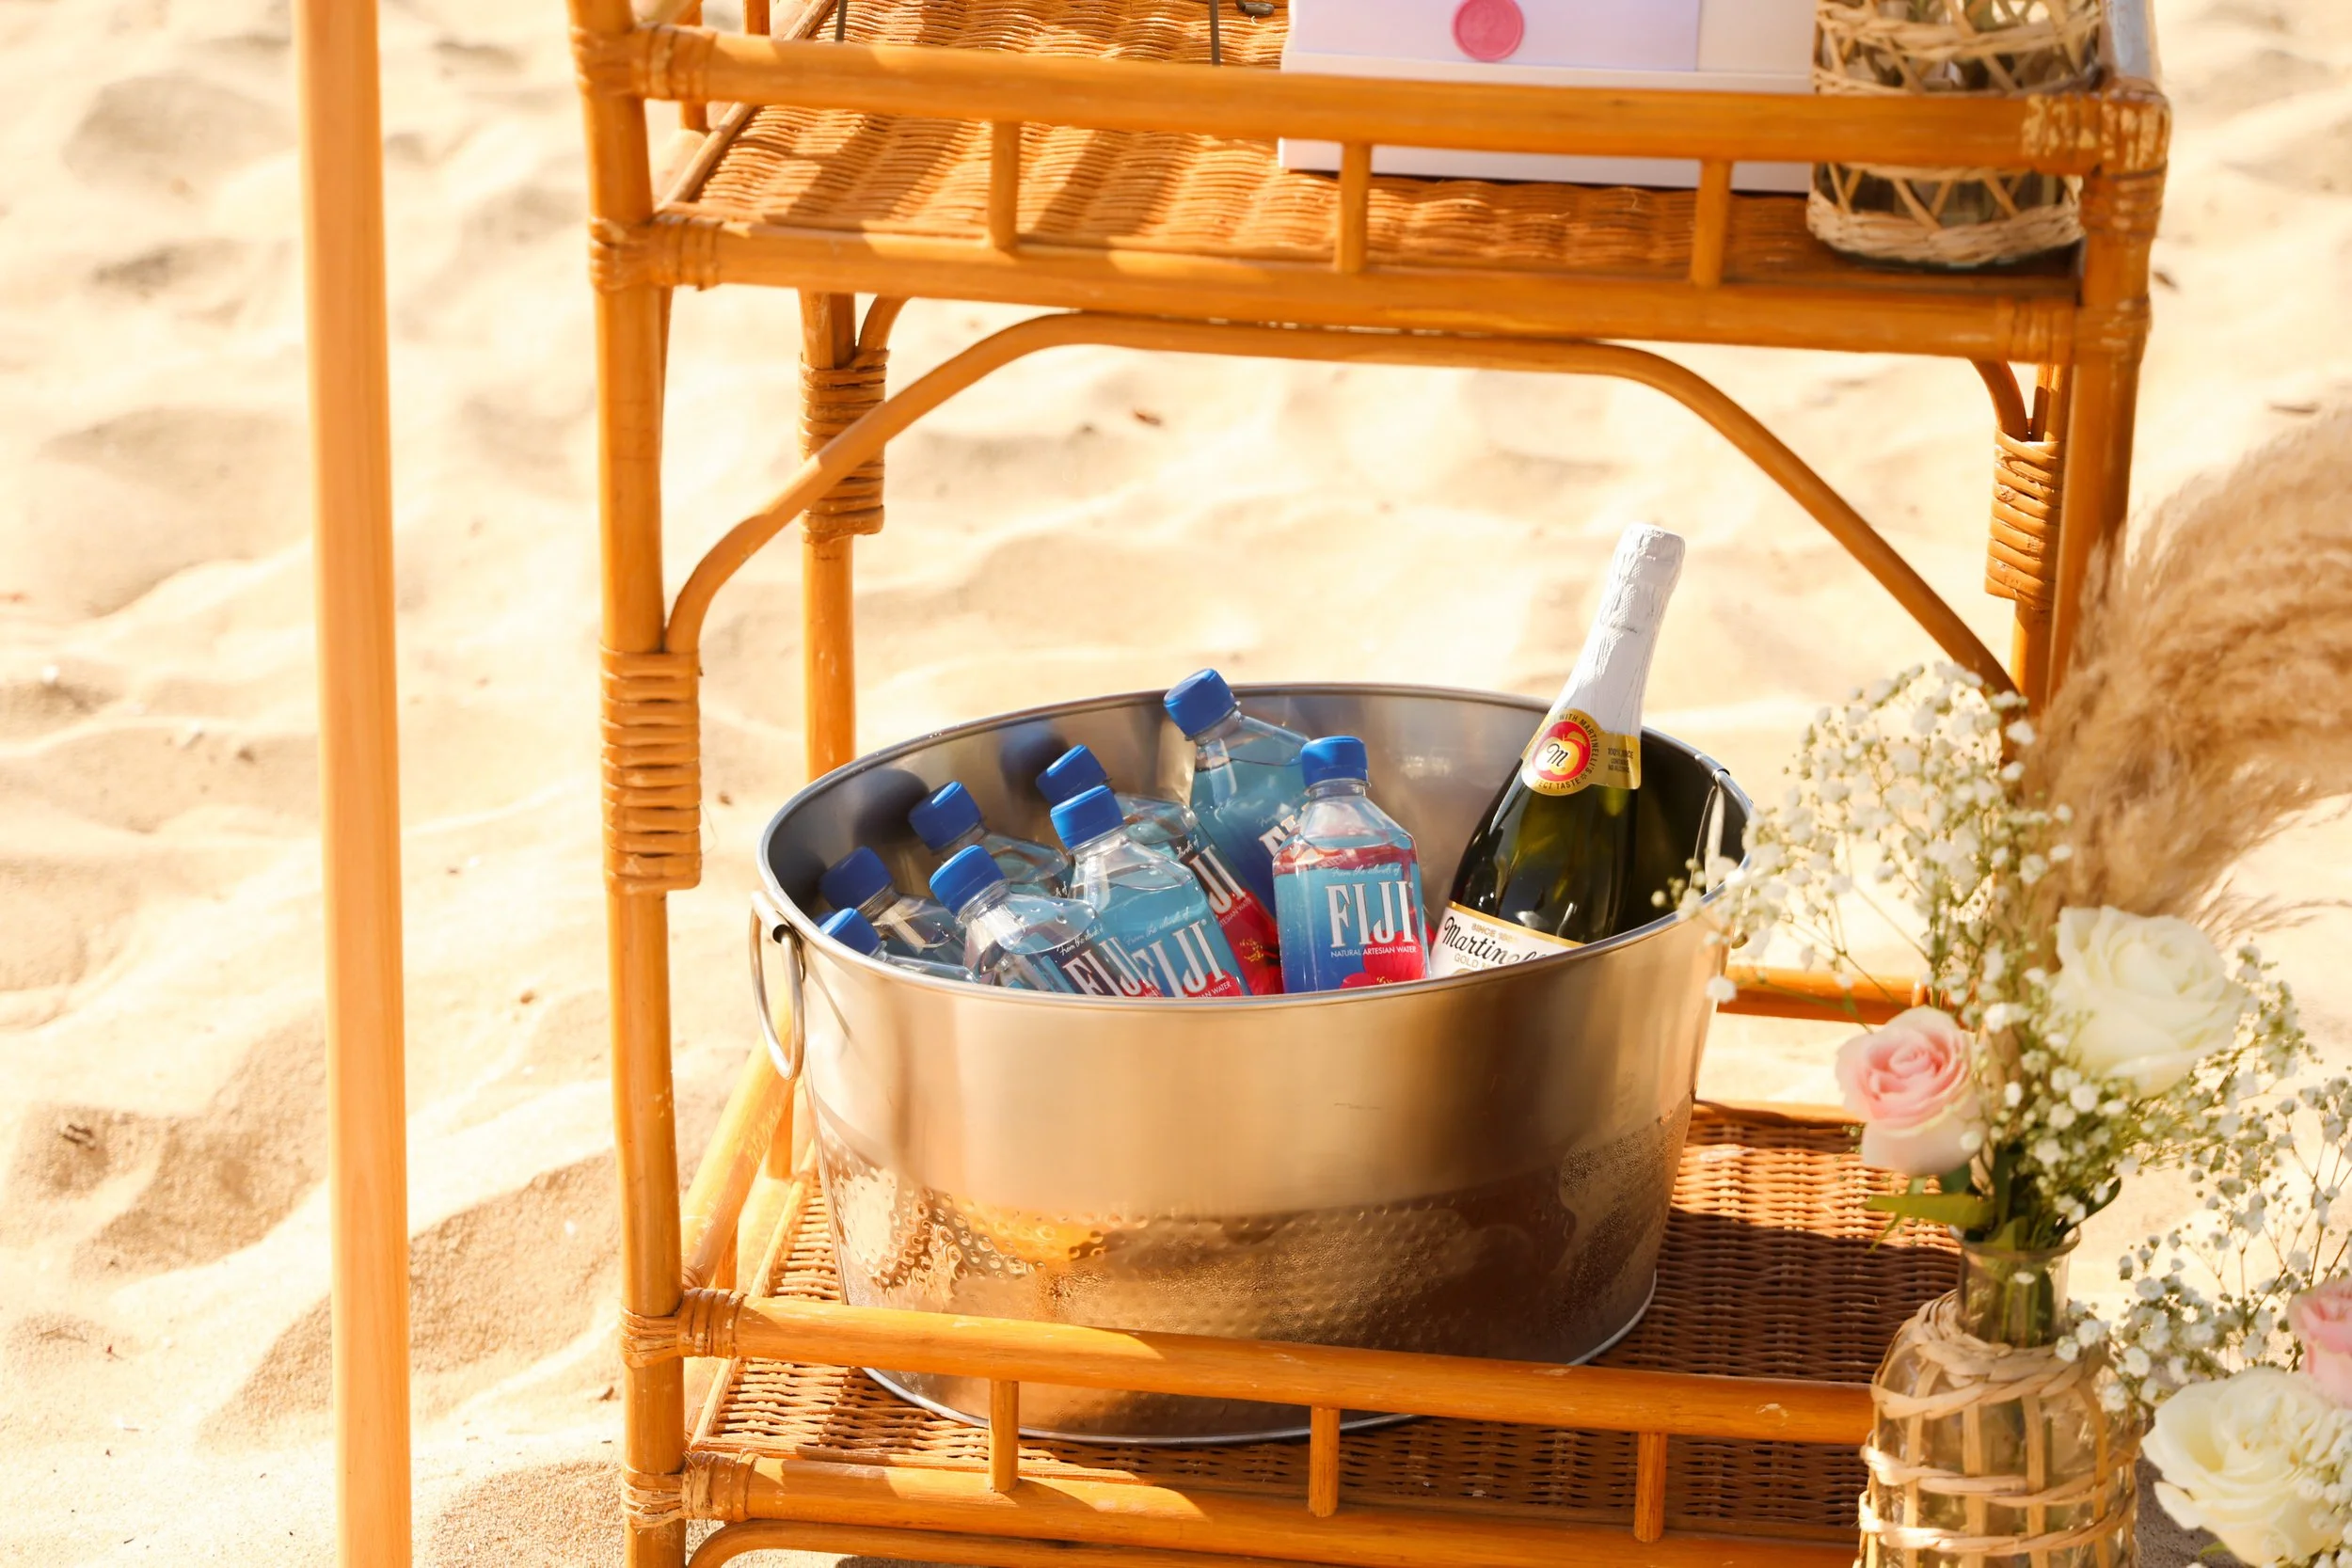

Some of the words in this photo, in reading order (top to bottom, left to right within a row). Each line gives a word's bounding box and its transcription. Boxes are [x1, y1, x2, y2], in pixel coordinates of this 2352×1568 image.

[1557, 778, 1581, 790] TASTE
[1325, 880, 1415, 948] FIJI
[1330, 948, 1362, 958] NATURAL
[1362, 945, 1395, 956] ARTESIAN
[1395, 944, 1418, 954] WATER
[1454, 953, 1479, 970] GOLD
[1212, 981, 1232, 996] WATER
